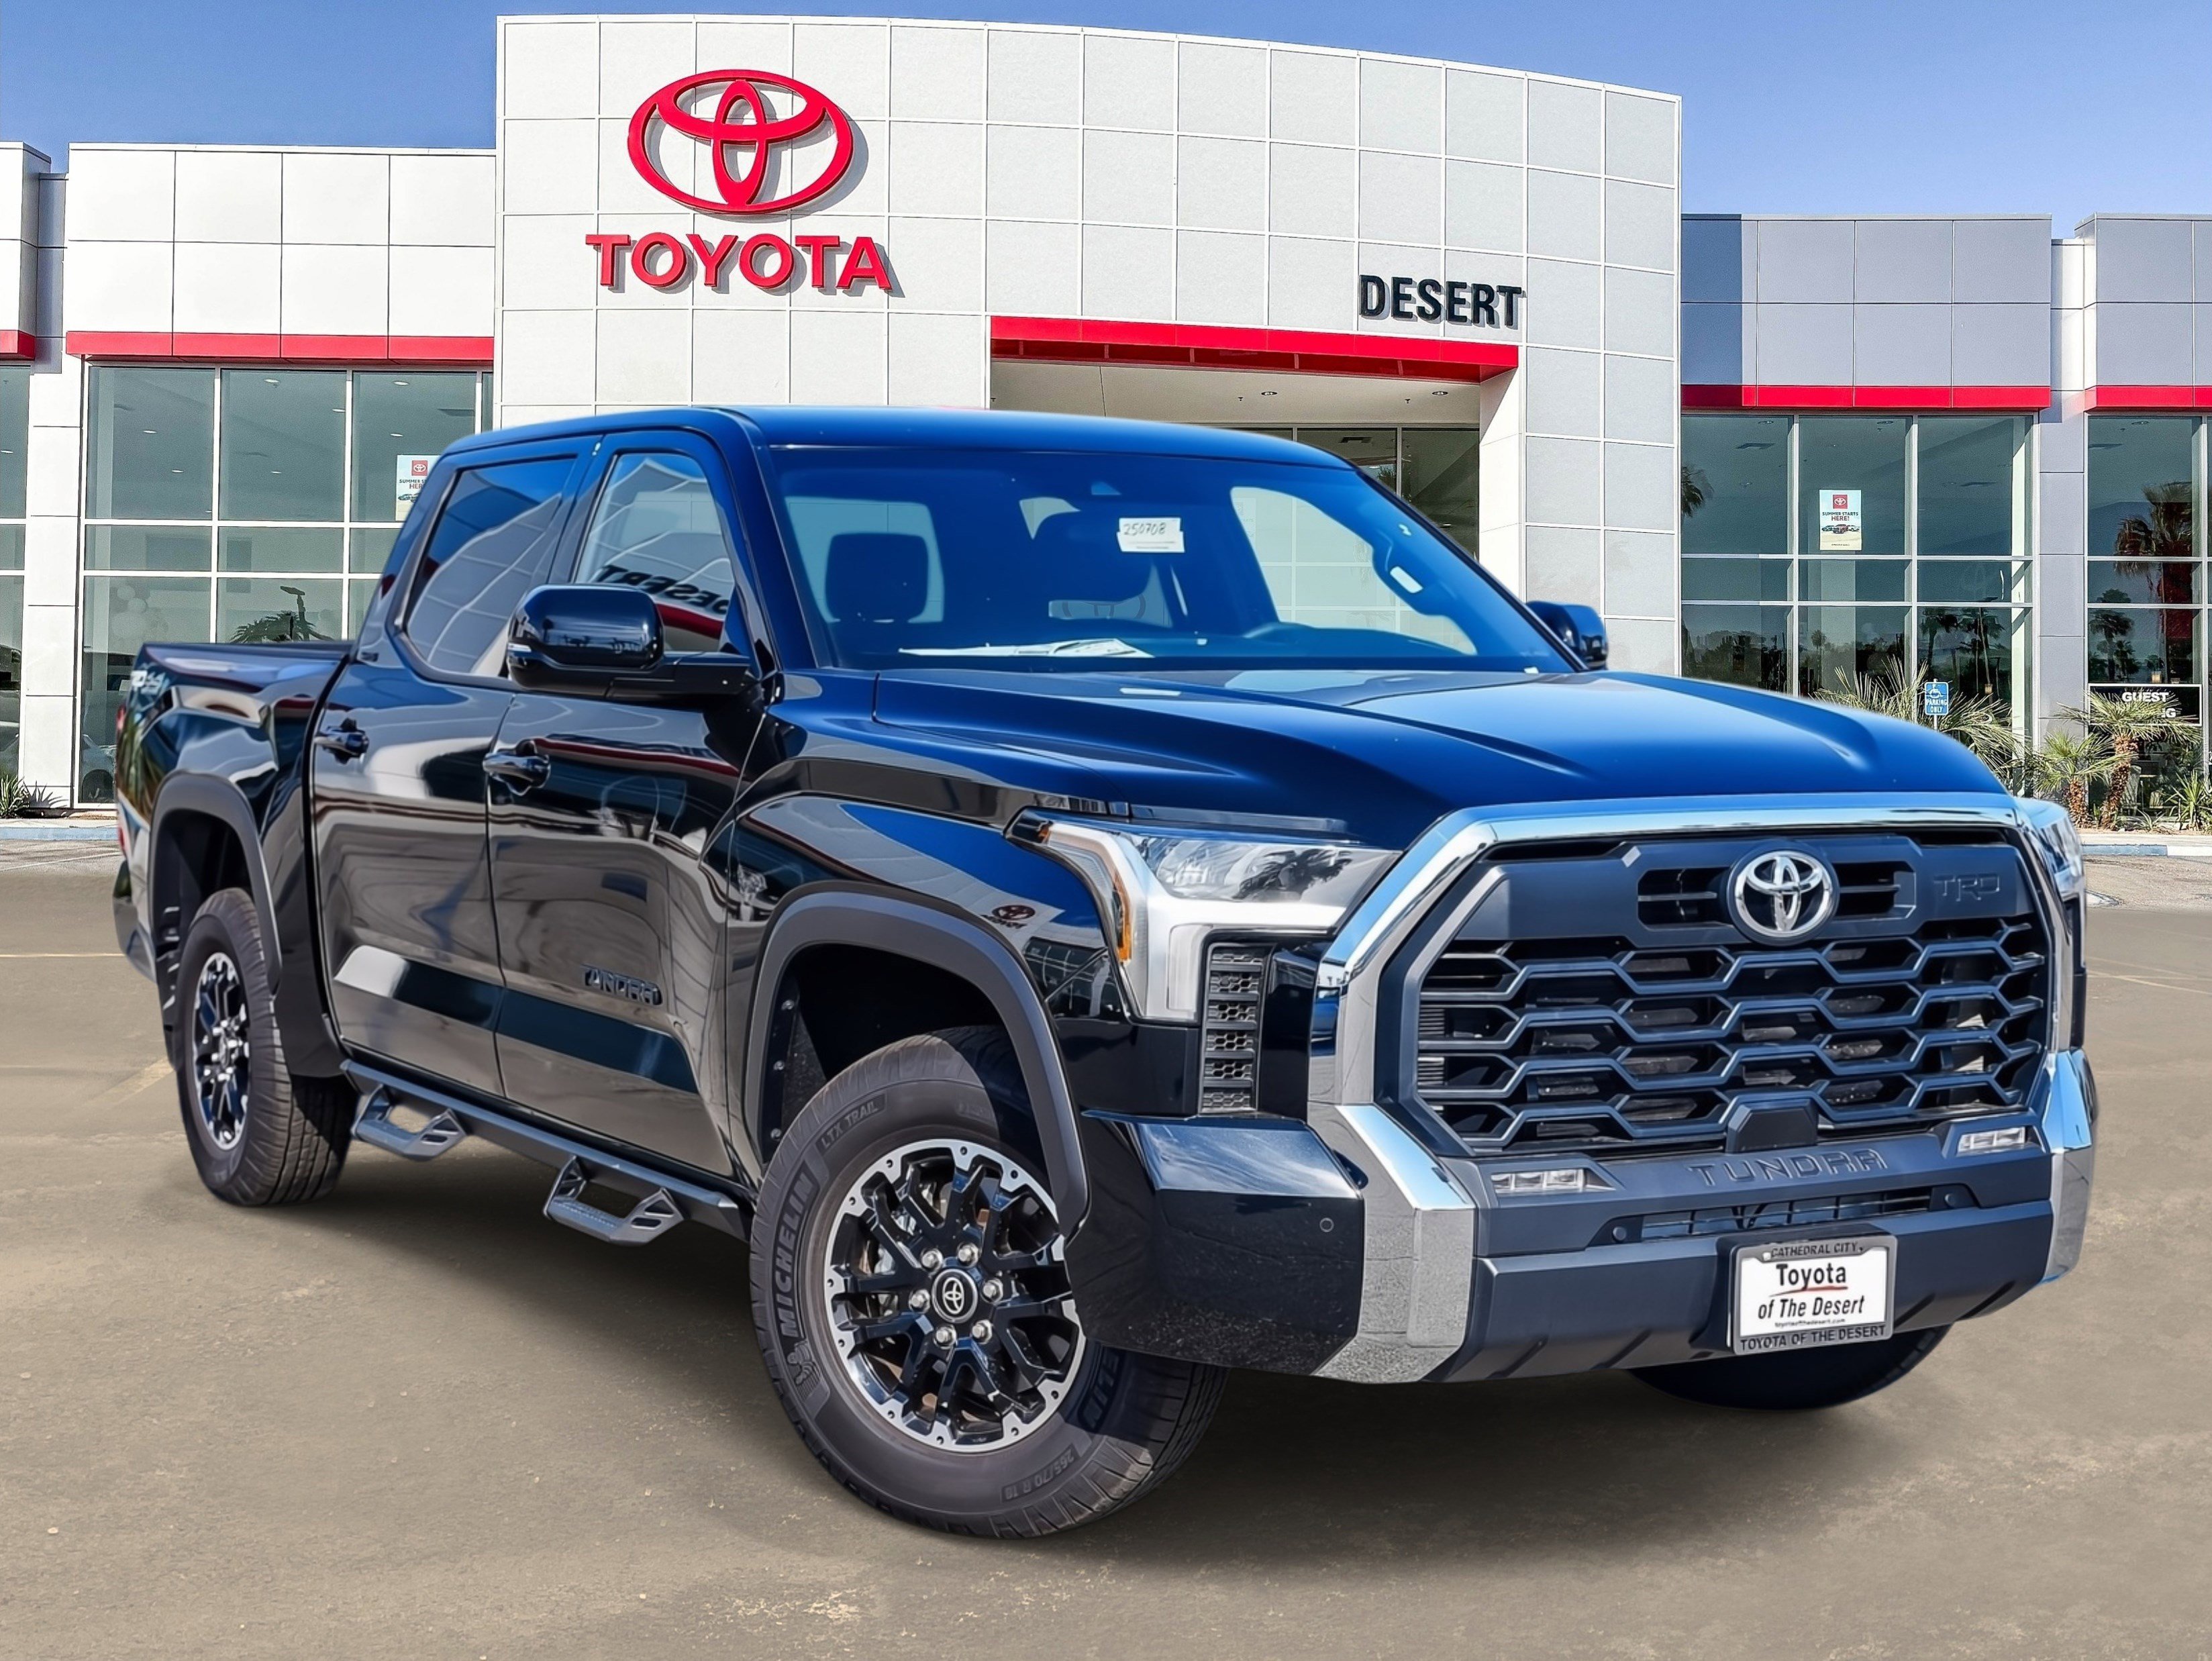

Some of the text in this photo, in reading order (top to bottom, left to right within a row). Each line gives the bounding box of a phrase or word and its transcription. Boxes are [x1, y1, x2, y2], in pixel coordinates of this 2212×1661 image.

[585, 232, 892, 291] TOYOTA
[1359, 274, 1522, 327] DESERT
[1123, 522, 1166, 536] 250708
[2121, 692, 2169, 702] GUEST
[1933, 874, 2000, 901] TRD
[821, 1103, 878, 1148] LTX TRAIL
[1688, 1148, 1889, 1187] TUNDRA
[774, 1173, 814, 1338] MICHELIN
[1771, 1242, 1858, 1257] CATHEDRAL CITY
[1776, 1262, 1846, 1289] Toyota
[1758, 1295, 1865, 1319] of The Desert
[1741, 1325, 1886, 1351] TOYOTA OF THE DESERT
